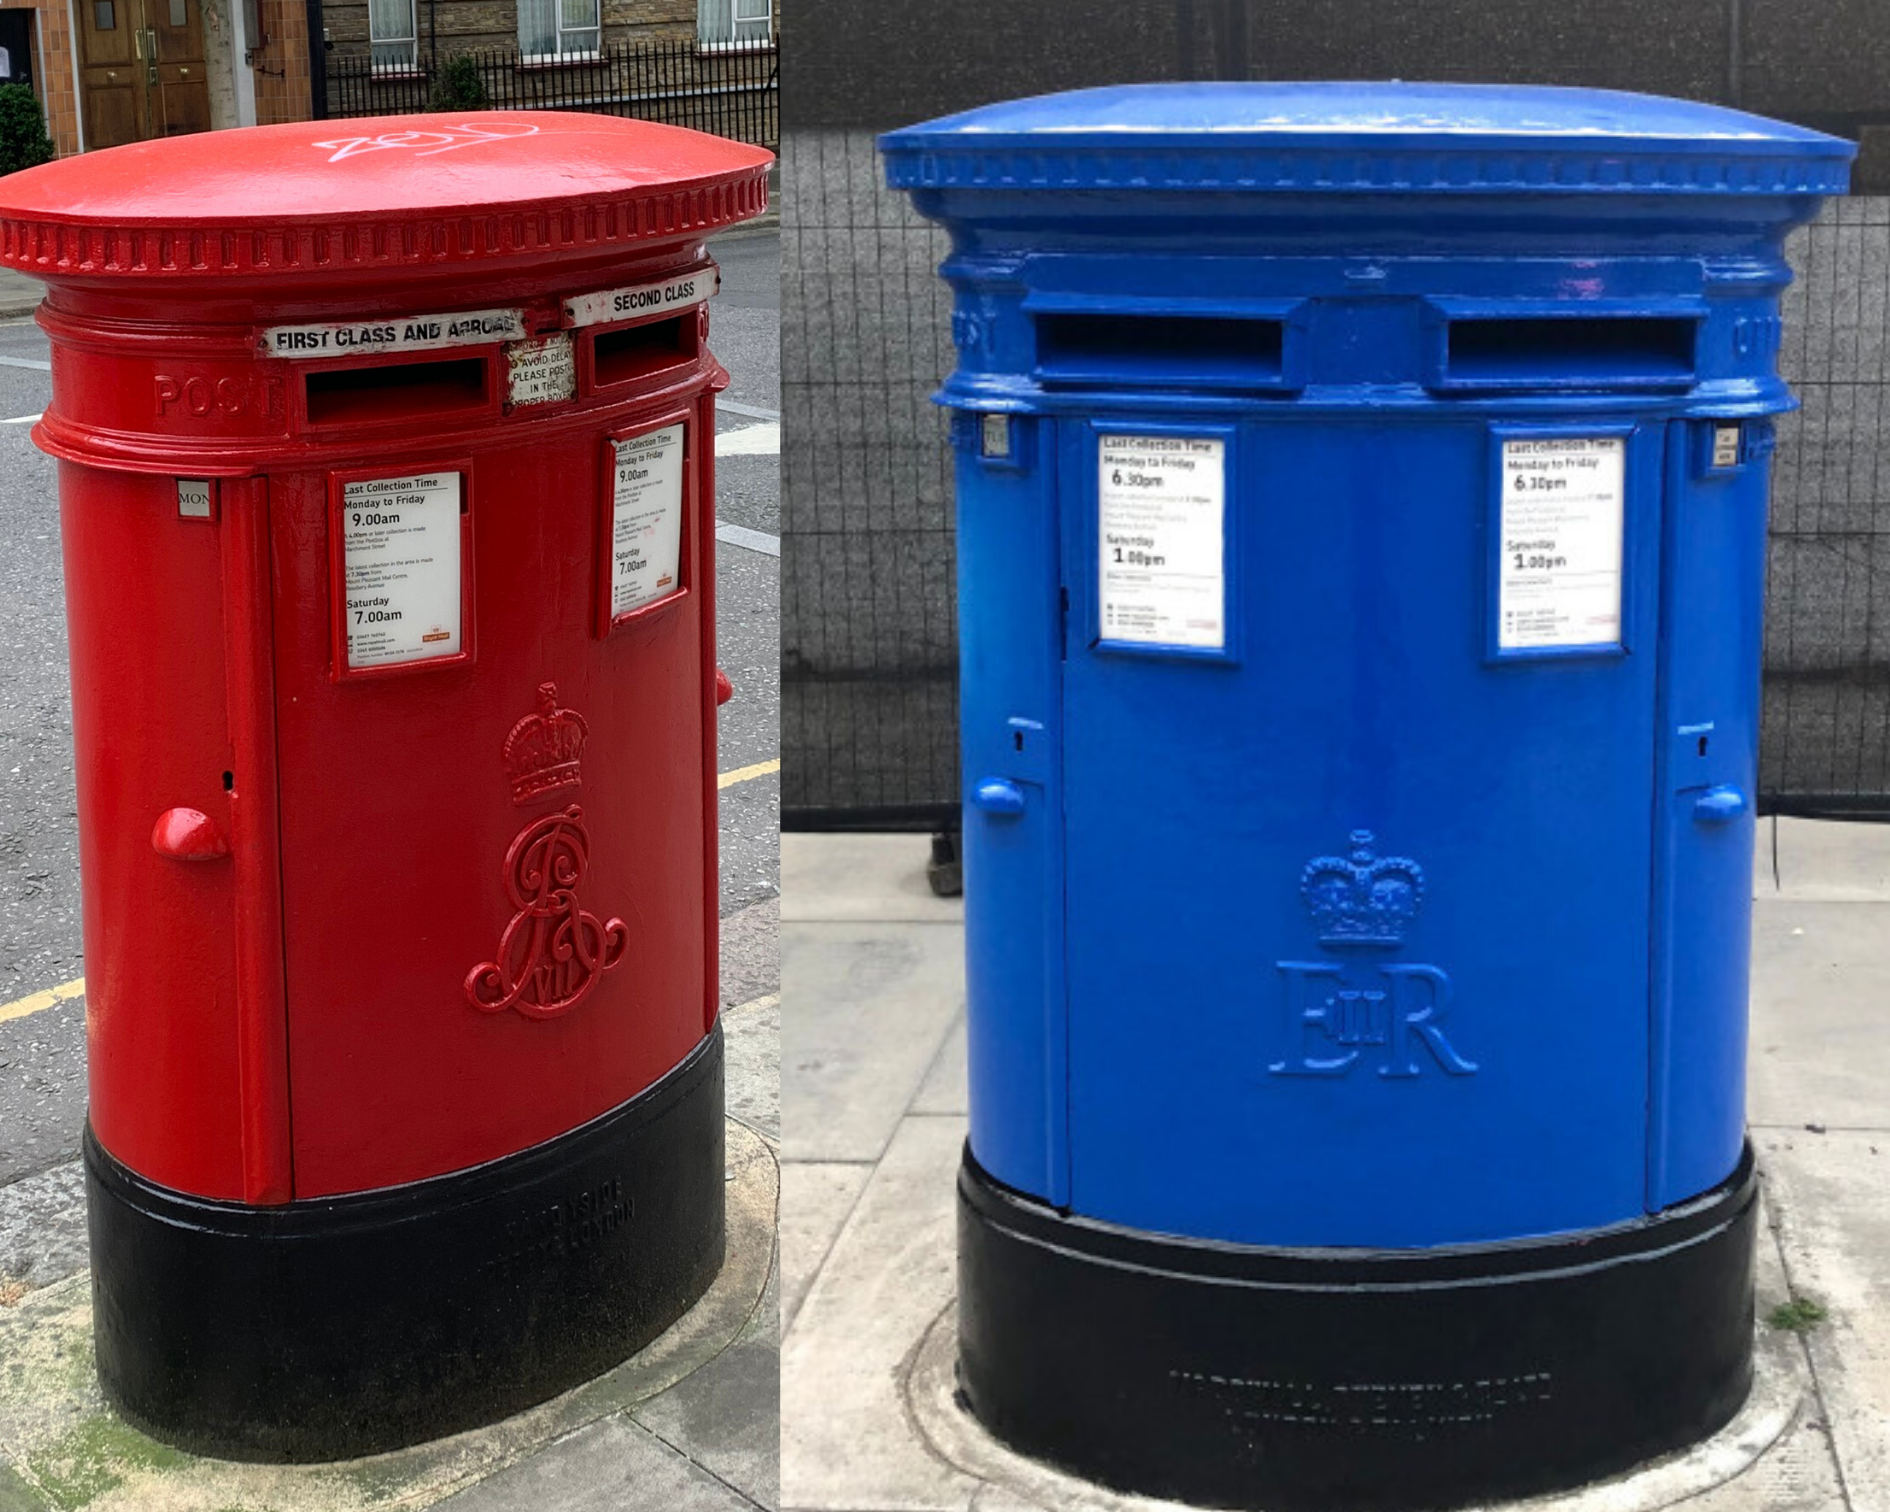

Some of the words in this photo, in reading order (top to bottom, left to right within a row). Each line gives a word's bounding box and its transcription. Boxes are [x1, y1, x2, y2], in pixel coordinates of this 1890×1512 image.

[614, 289, 662, 312] SECOND
[665, 281, 695, 302] CLASS
[276, 330, 330, 350] FIRST
[335, 326, 396, 347] CLASS
[403, 322, 441, 341] AND
[522, 355, 548, 368] AVOID
[551, 350, 571, 363] DELAY
[513, 368, 546, 382] PLEASE
[530, 383, 539, 393] IN
[542, 380, 557, 391] THE
[154, 374, 282, 417] POST
[629, 438, 656, 450] Collection
[657, 434, 671, 443] Time
[1508, 441, 1531, 454] Last
[646, 451, 663, 460] Friday
[1104, 455, 1146, 470] Monday
[1148, 457, 1160, 467] to
[1161, 457, 1195, 472] Friday
[1508, 459, 1550, 473] Monday
[1552, 458, 1563, 470] to
[1565, 457, 1599, 471] Friday
[620, 469, 648, 483] 9.00am
[344, 485, 364, 495] Last
[366, 480, 412, 493] Collection
[414, 478, 438, 488] Time
[179, 493, 210, 505] MON
[344, 498, 381, 510] Monday
[384, 498, 393, 506] to
[396, 494, 425, 505] Friday
[352, 512, 400, 527] 9.00am
[615, 547, 640, 561] Saturday
[620, 560, 647, 576] 7.00am
[347, 596, 390, 609] Saturday
[355, 610, 402, 625] 7.00am
